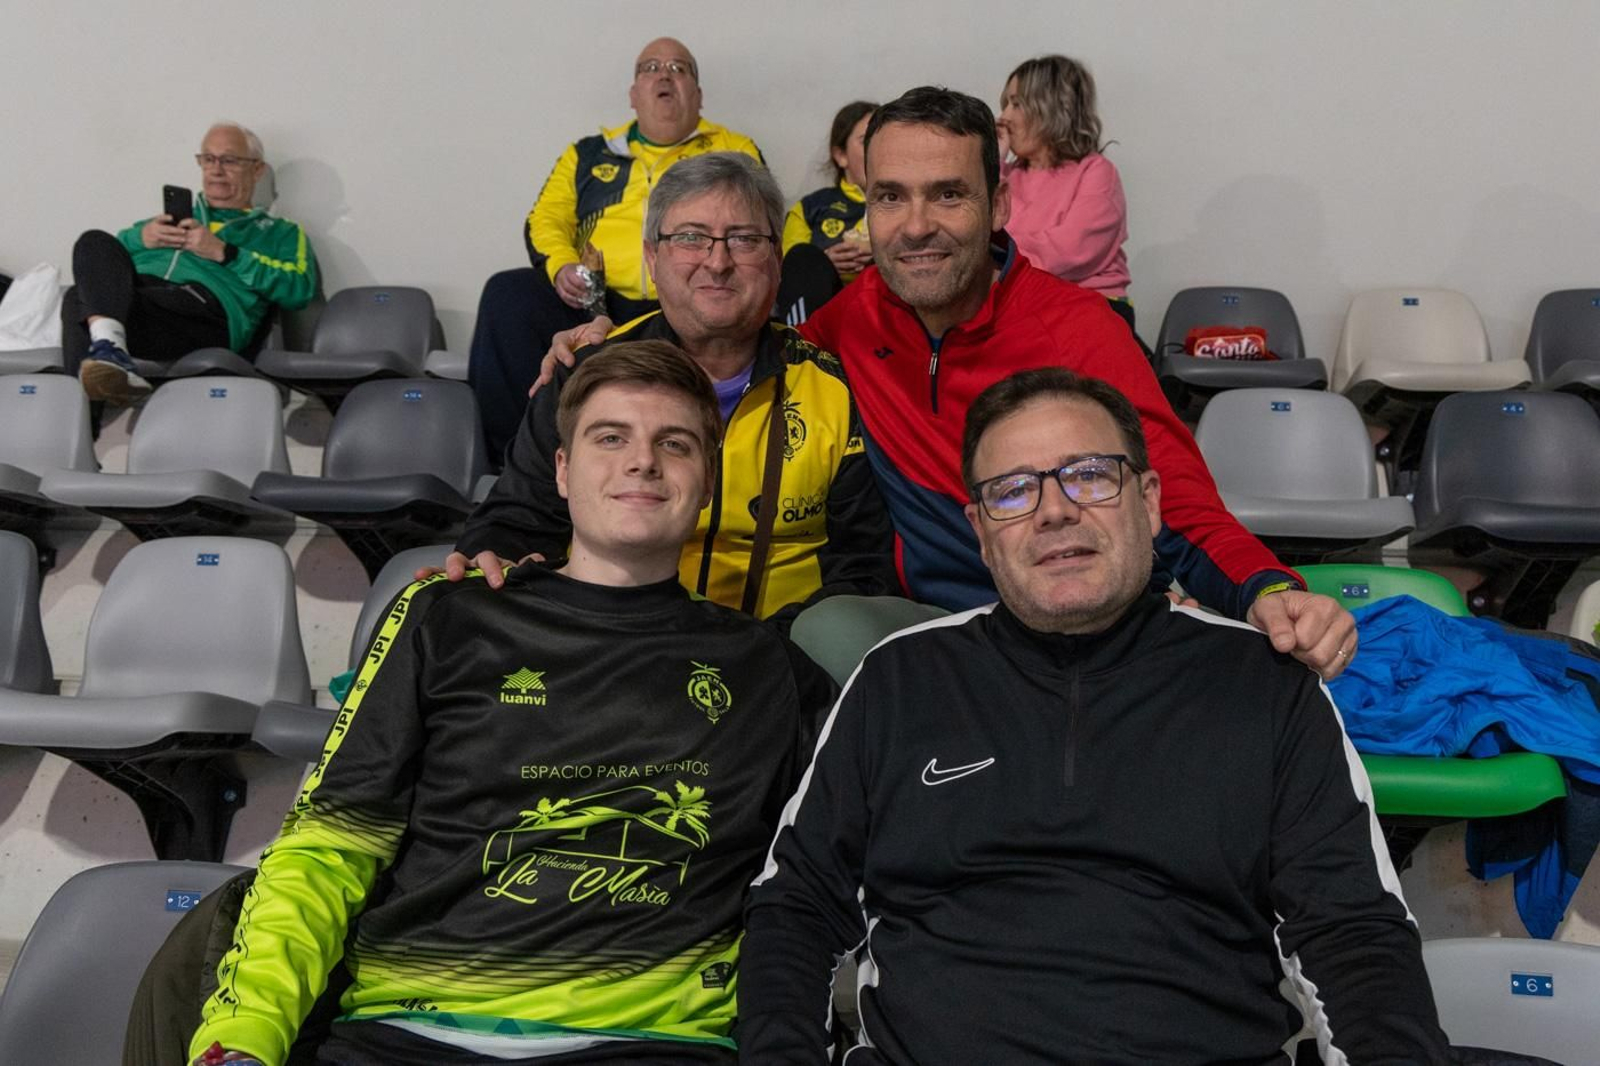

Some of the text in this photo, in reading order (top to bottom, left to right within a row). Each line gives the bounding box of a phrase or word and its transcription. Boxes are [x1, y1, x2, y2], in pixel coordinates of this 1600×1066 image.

[782, 502, 823, 523] OLMO
[1351, 586, 1360, 596] 6
[390, 596, 410, 625] JPI
[369, 635, 390, 665] JPI
[500, 692, 546, 706] luanvi
[335, 707, 355, 737] JPI
[521, 760, 709, 779] ESPACIO PARA EVENTOS
[536, 854, 588, 872] Hacienda
[484, 852, 539, 905] La
[177, 895, 191, 908] 12
[1526, 978, 1538, 993] 6
